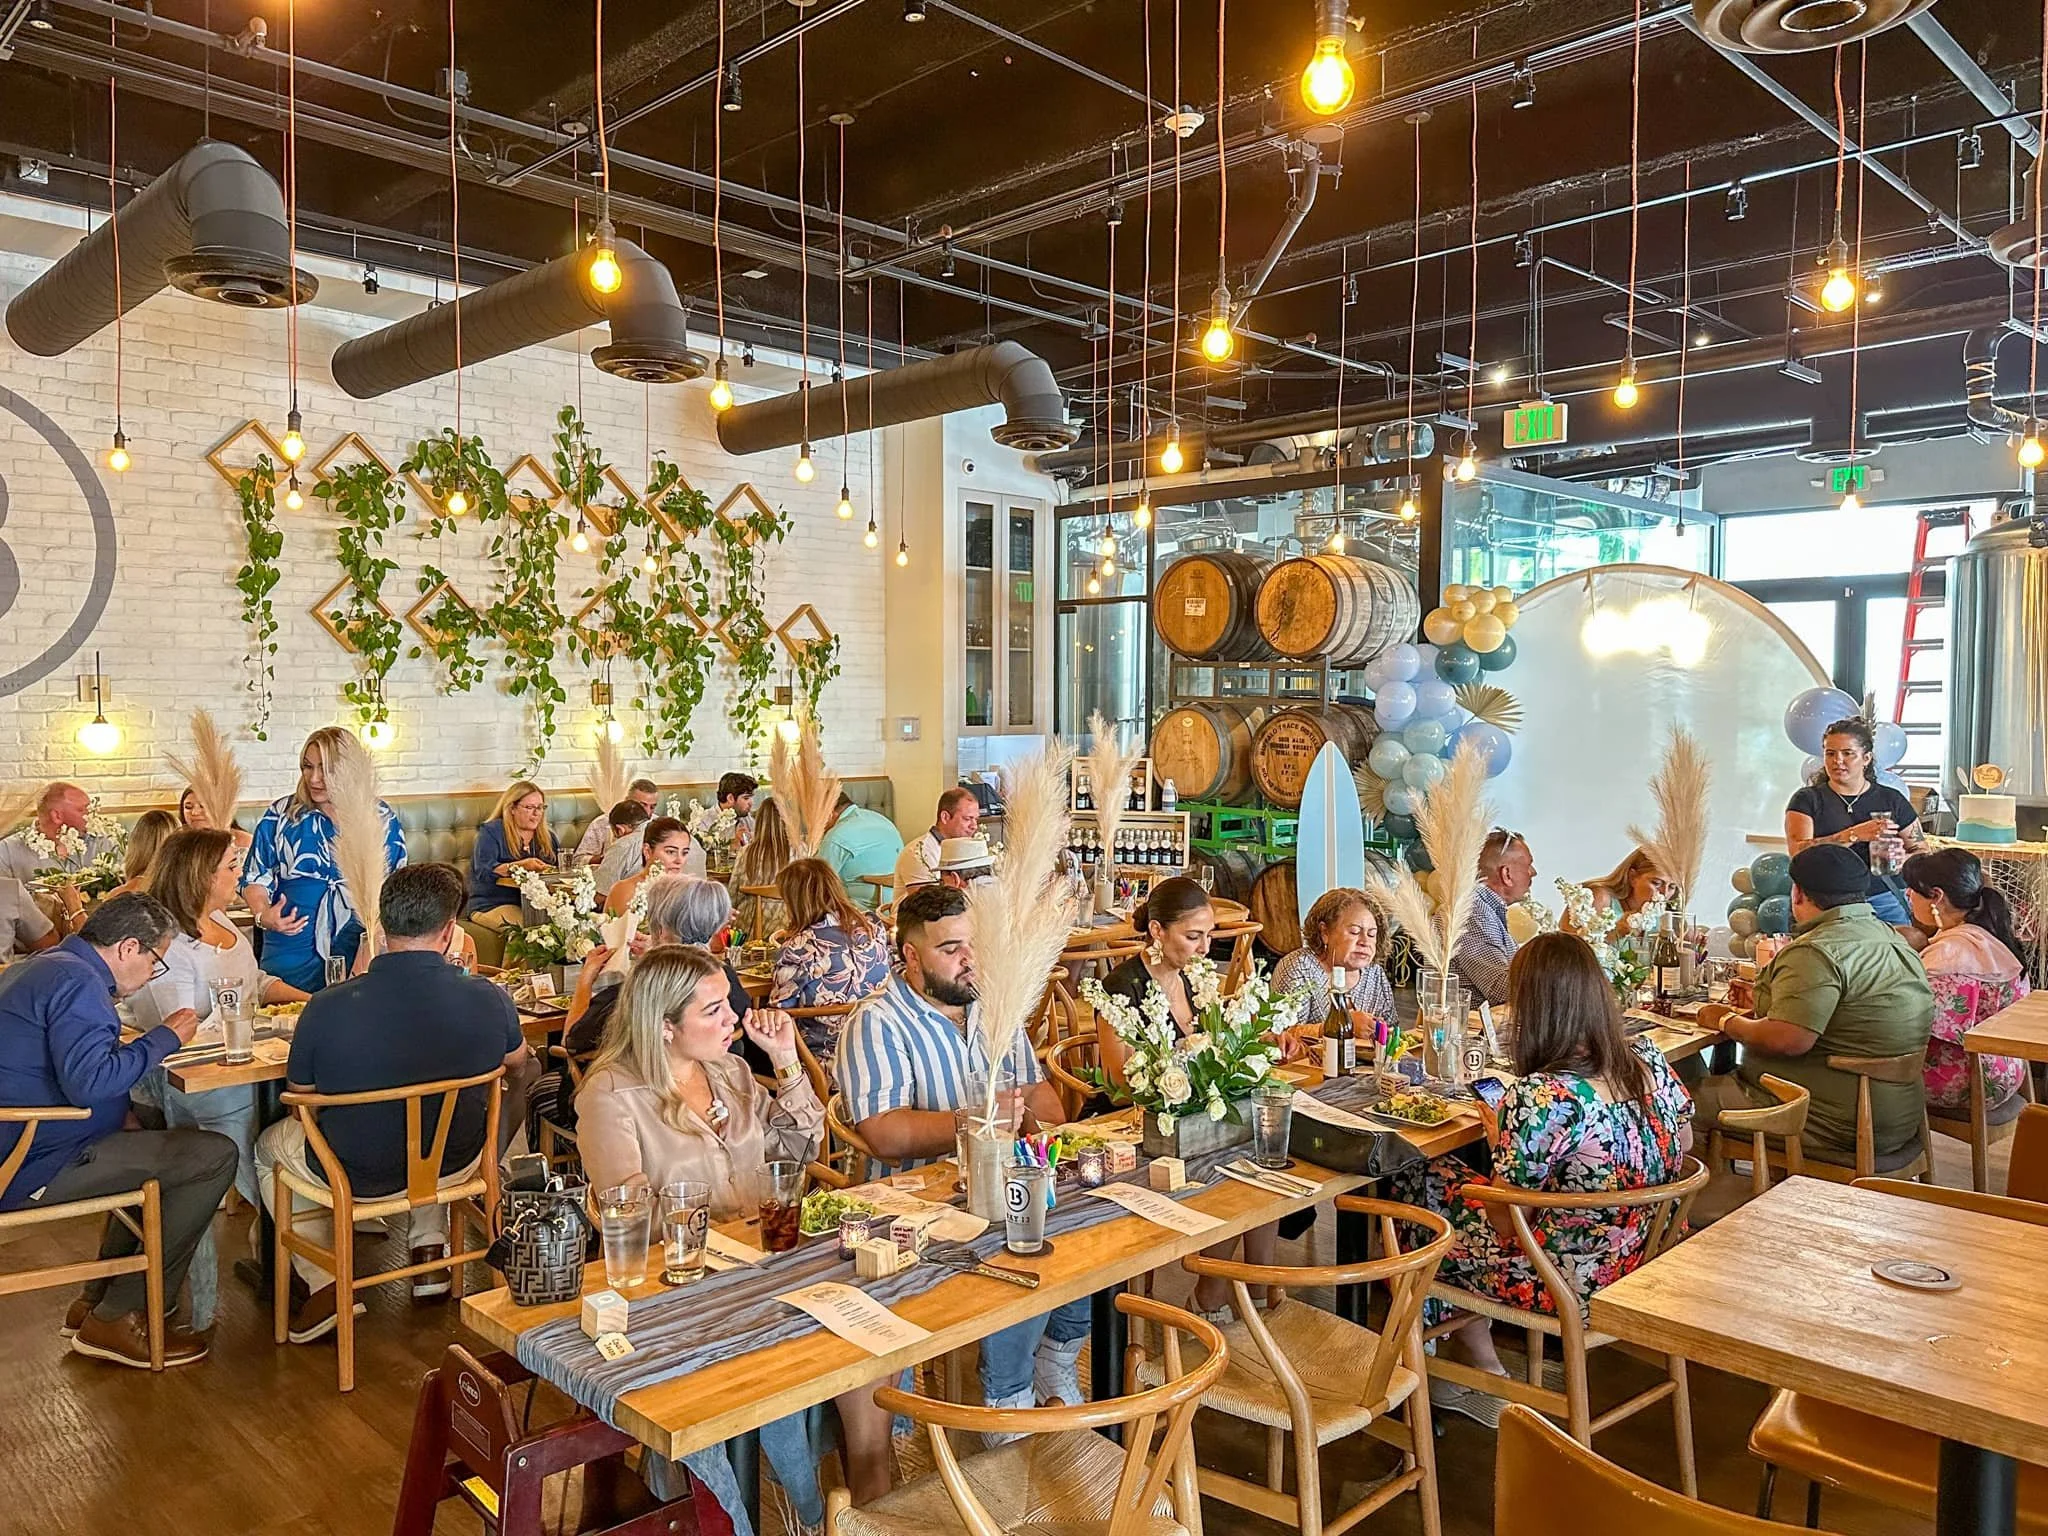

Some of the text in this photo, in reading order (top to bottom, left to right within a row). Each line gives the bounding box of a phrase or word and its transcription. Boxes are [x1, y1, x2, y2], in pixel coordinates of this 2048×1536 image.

[1514, 406, 1555, 443] EXIT
[1279, 723, 1299, 731] TRACE
[1300, 726, 1319, 747] DISTILL
